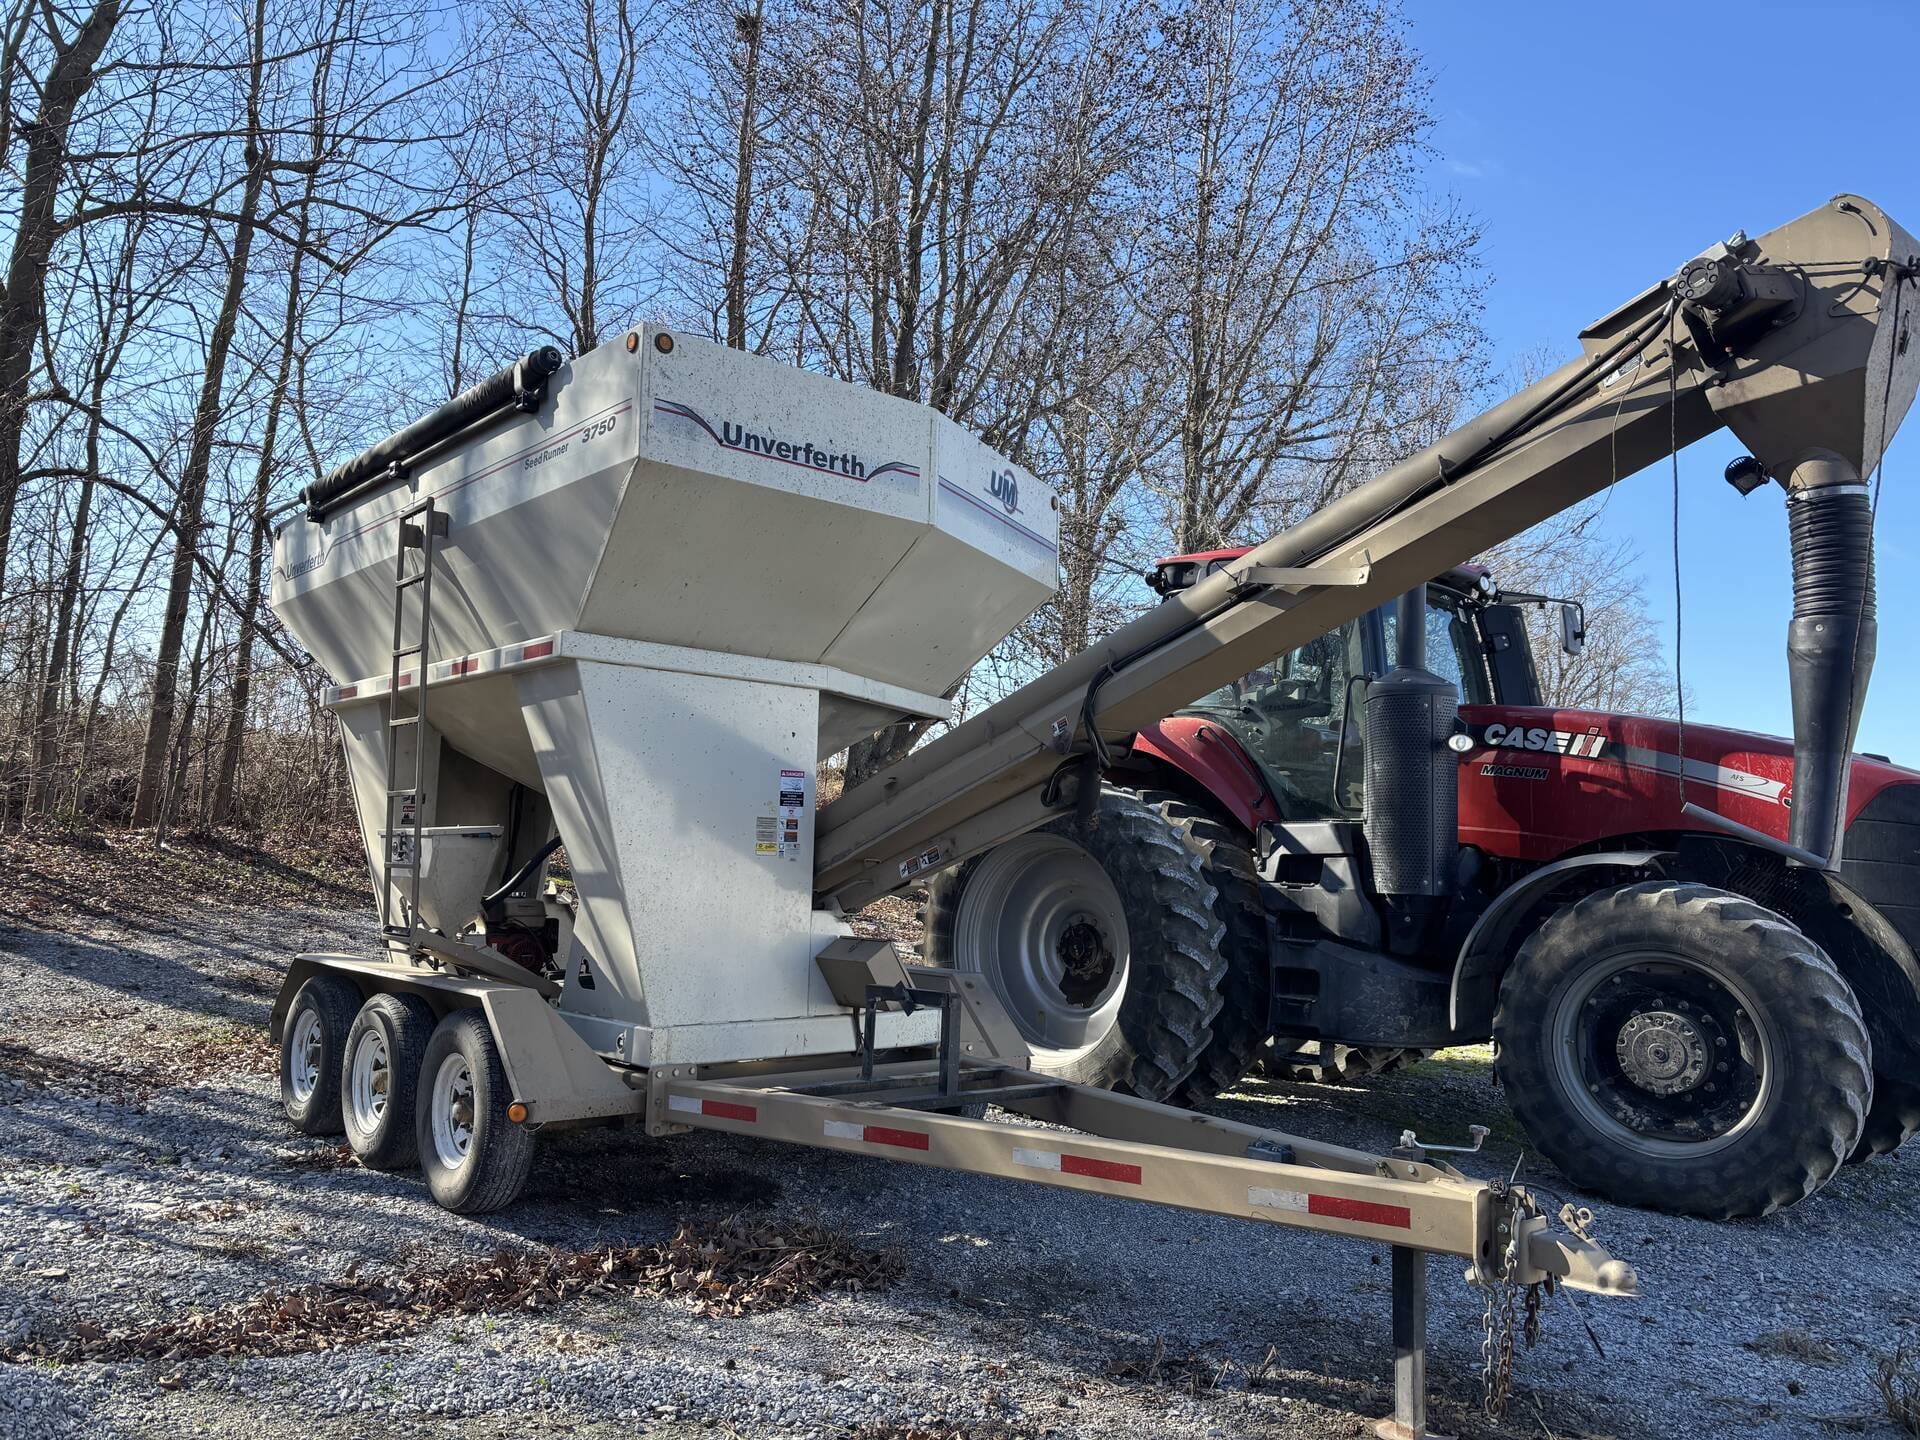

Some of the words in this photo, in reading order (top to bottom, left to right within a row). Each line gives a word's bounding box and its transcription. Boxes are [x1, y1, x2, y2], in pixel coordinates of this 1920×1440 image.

[581, 416, 616, 443] 3750
[723, 421, 865, 478] Unverferth
[1484, 723, 1571, 754] CASE
[1481, 764, 1550, 780] MAGNUM
